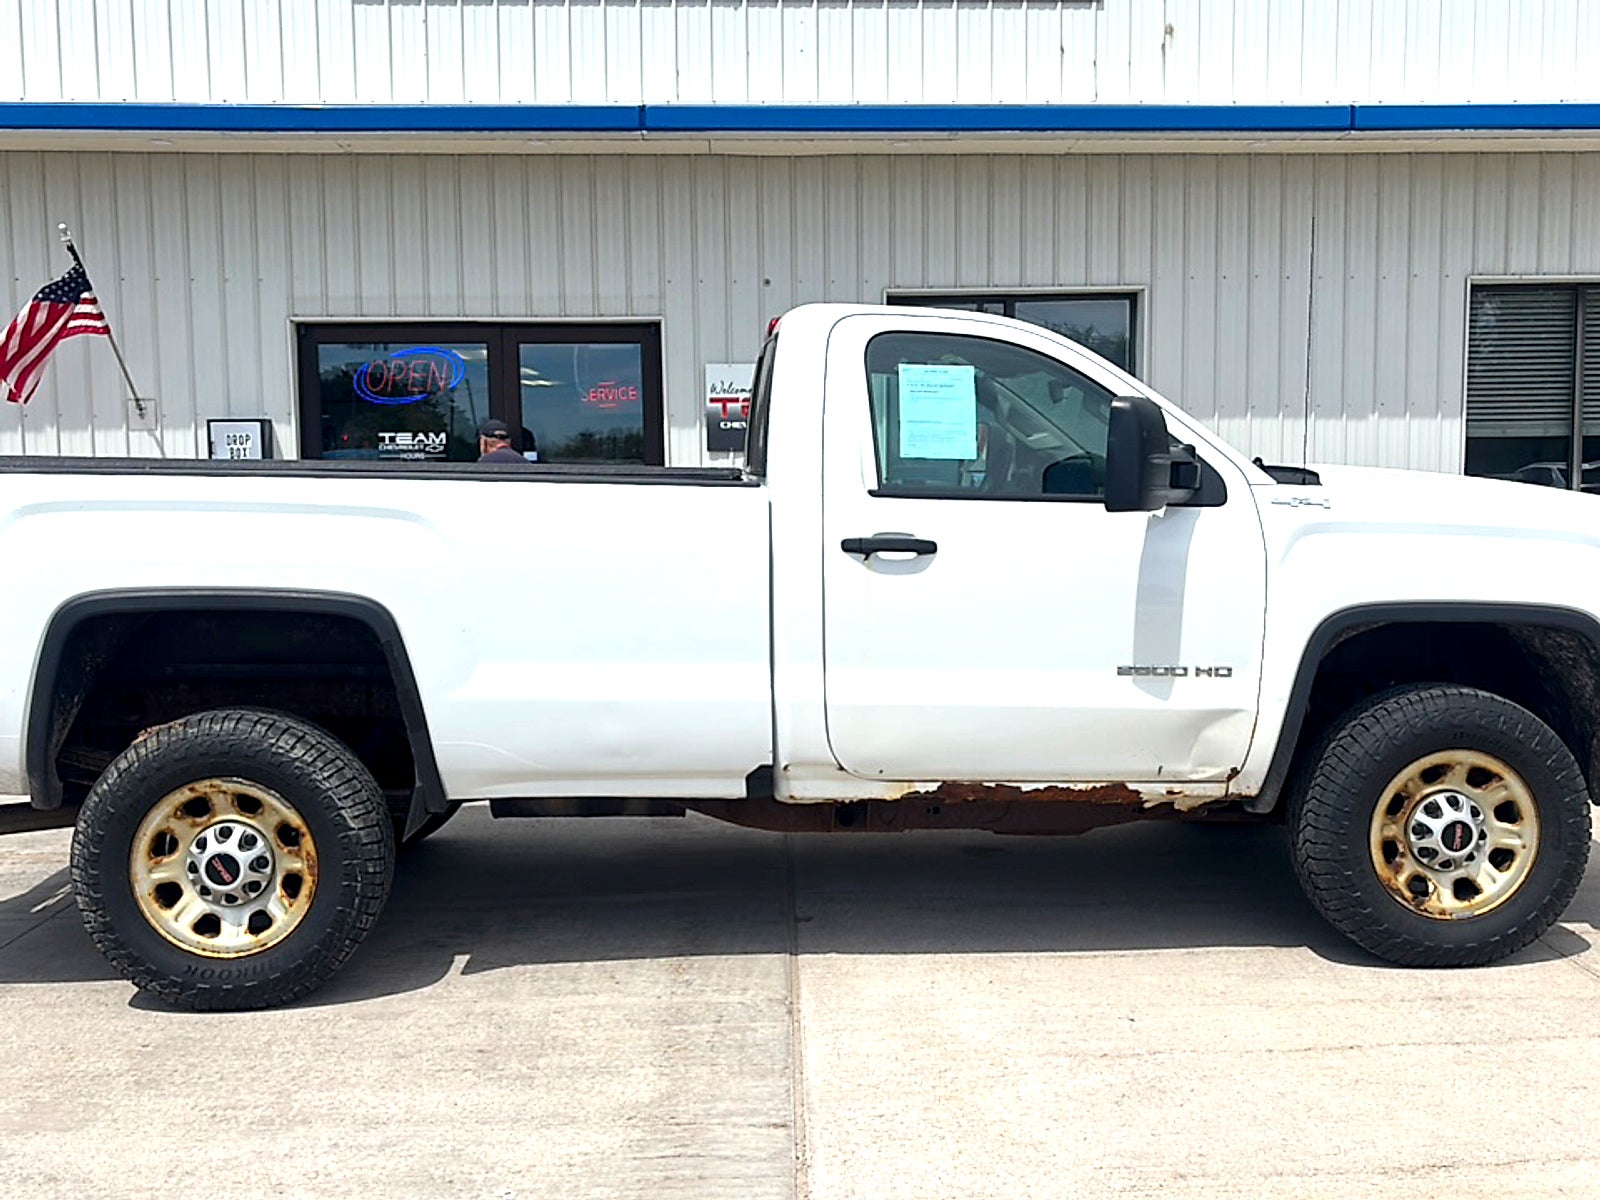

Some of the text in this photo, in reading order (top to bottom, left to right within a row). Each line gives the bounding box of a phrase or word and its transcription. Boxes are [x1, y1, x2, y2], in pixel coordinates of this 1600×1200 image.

[366, 360, 448, 393] OPEN
[226, 433, 251, 447] DROP
[378, 432, 446, 445] TEAM
[230, 447, 248, 460] BOX
[1195, 666, 1233, 678] HD
